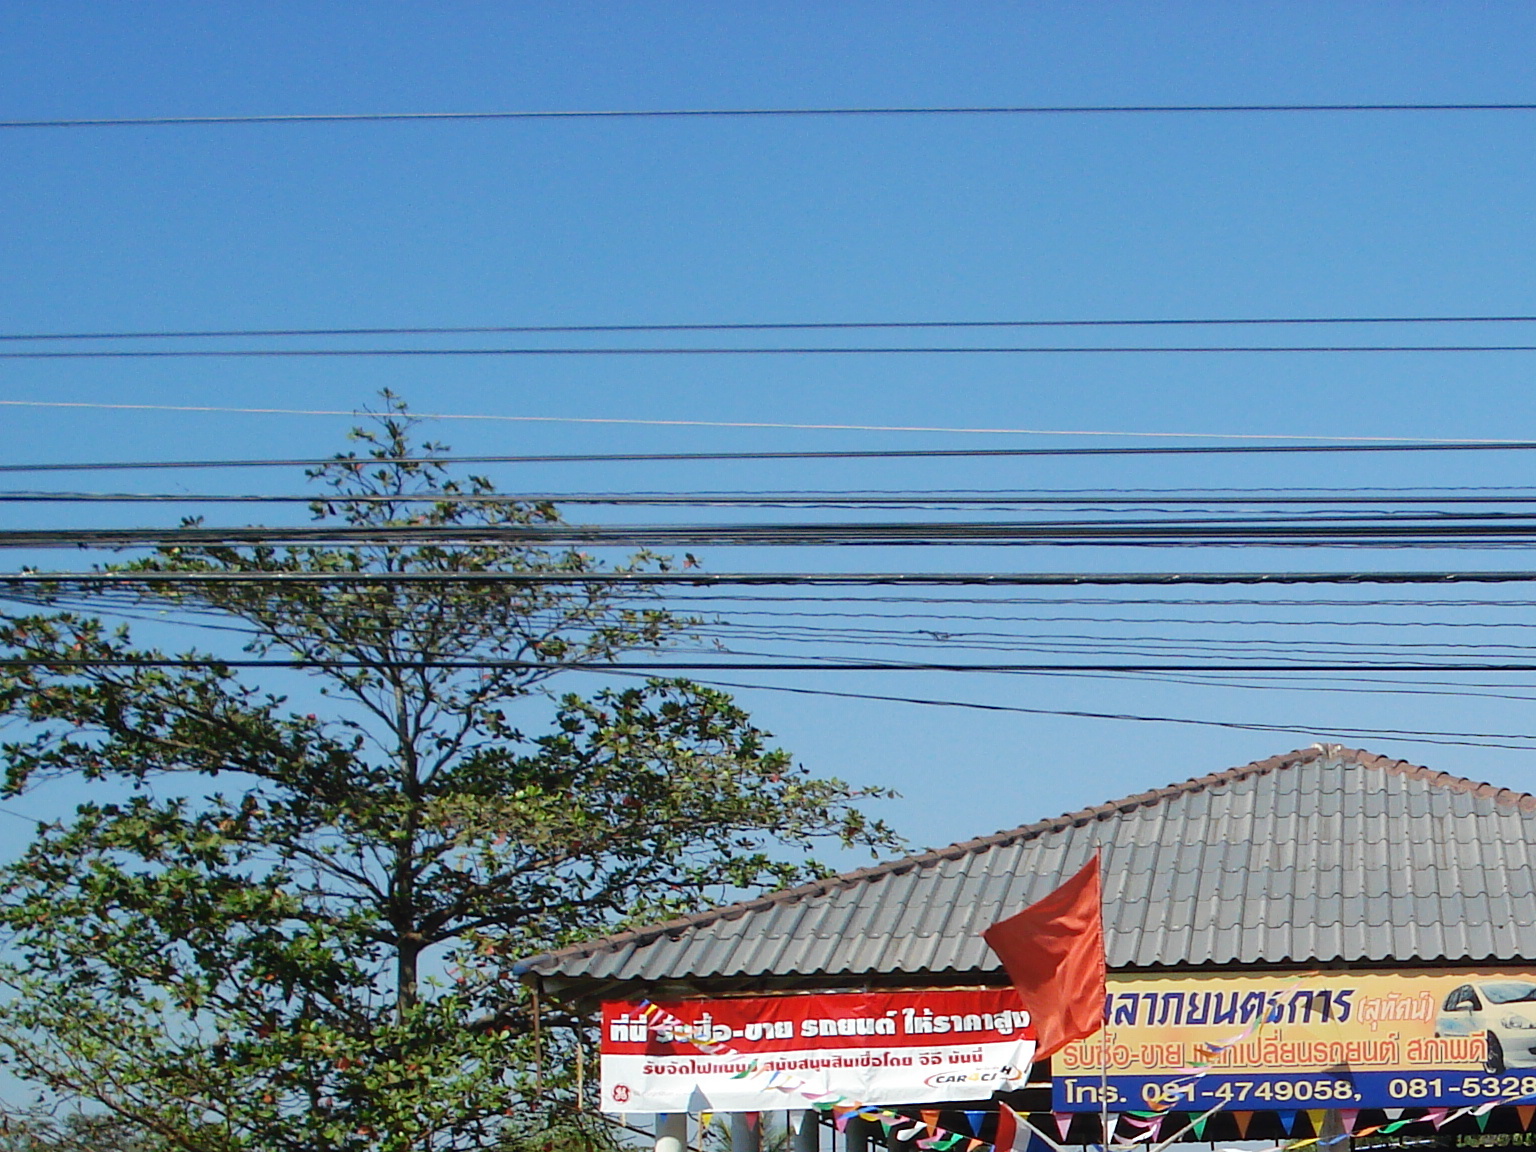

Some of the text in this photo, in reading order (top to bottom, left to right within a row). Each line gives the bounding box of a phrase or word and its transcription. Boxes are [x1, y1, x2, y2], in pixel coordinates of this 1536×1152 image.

[801, 1010, 897, 1037] รถยนต์
[902, 1008, 1031, 1035] ให้ราคาสูง
[1406, 1031, 1488, 1065] สภาพดี
[1065, 1078, 1128, 1104] โทร.
